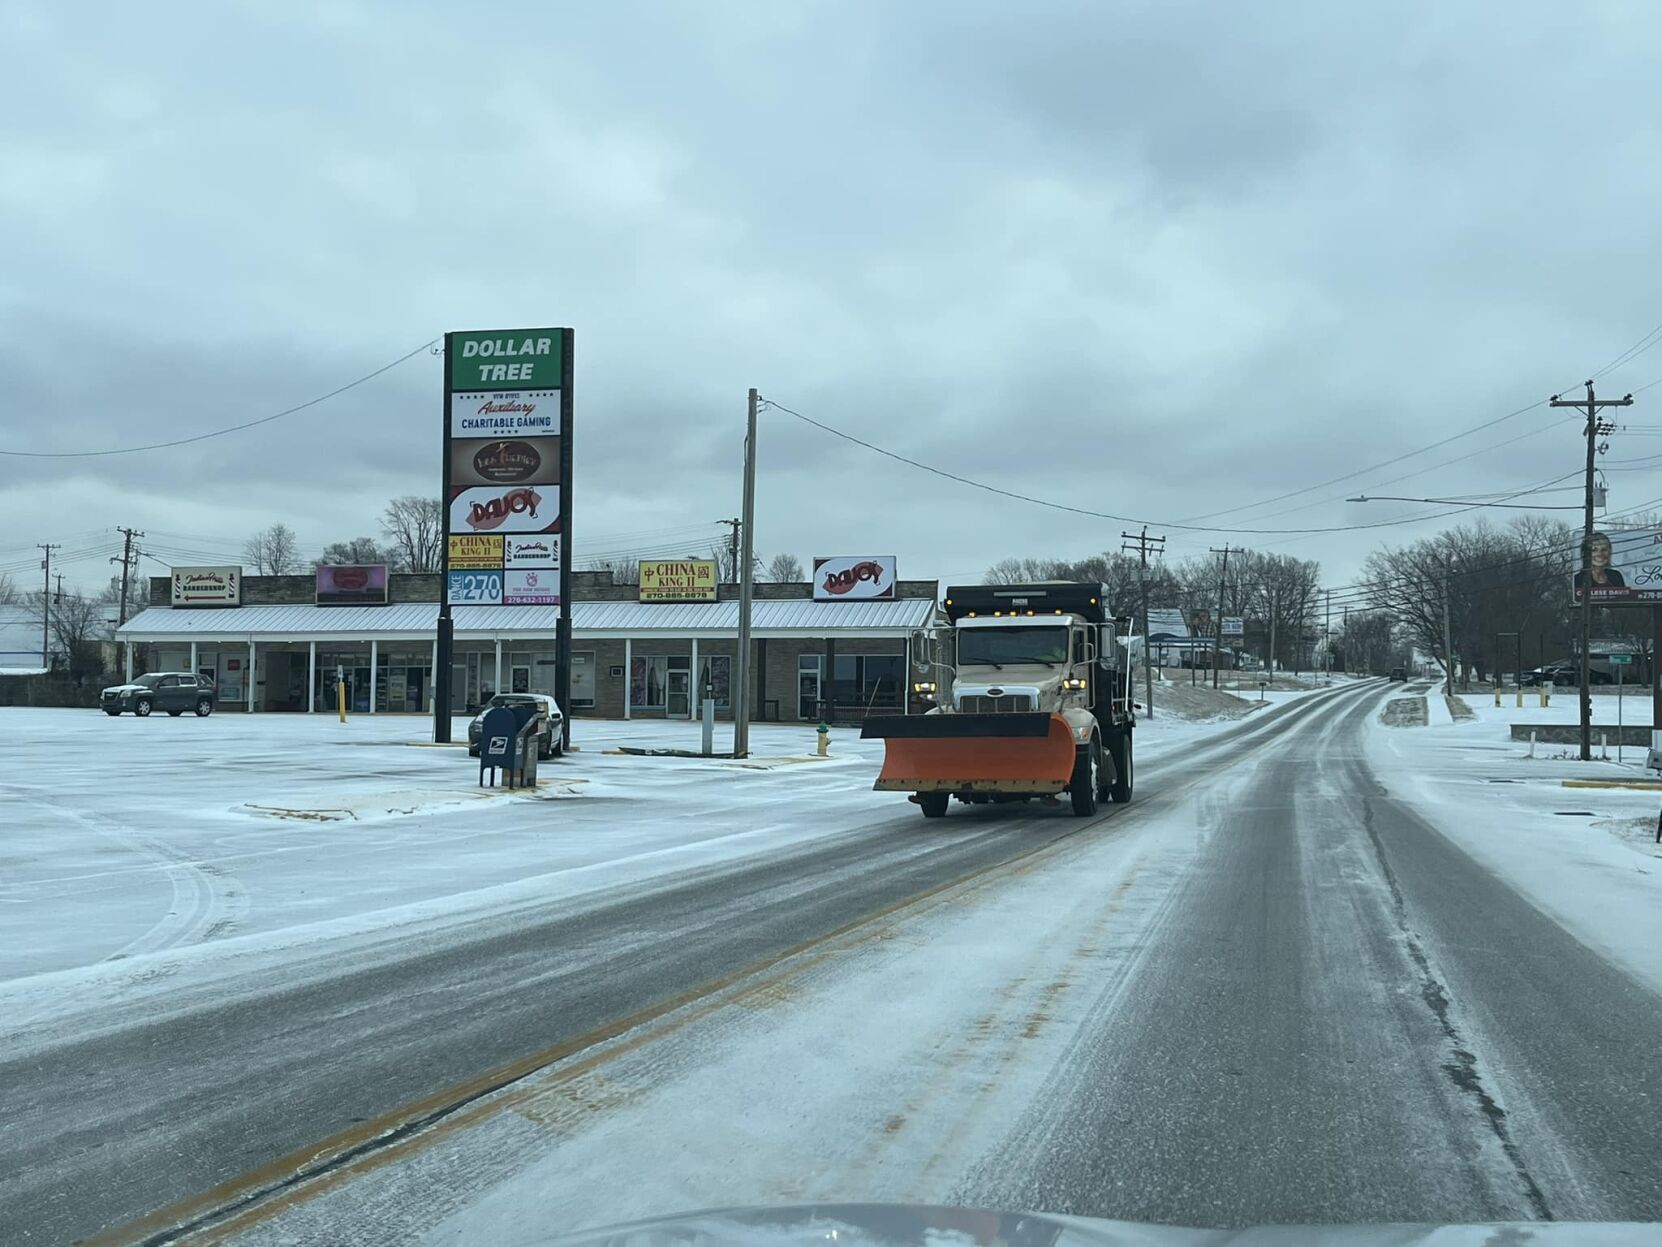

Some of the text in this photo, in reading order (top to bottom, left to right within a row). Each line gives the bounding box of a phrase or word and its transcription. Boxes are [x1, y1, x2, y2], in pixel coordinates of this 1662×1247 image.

[462, 338, 552, 358] DOLLAR
[479, 363, 535, 382] TREE
[477, 399, 537, 417] Auxiliary
[461, 416, 551, 429] CHARITABLE GAMING
[459, 536, 492, 546] CHINA
[461, 547, 491, 555] KING II
[656, 563, 697, 576] CHINA
[451, 574, 500, 601] DANCE 270
[659, 576, 695, 587] KING II
